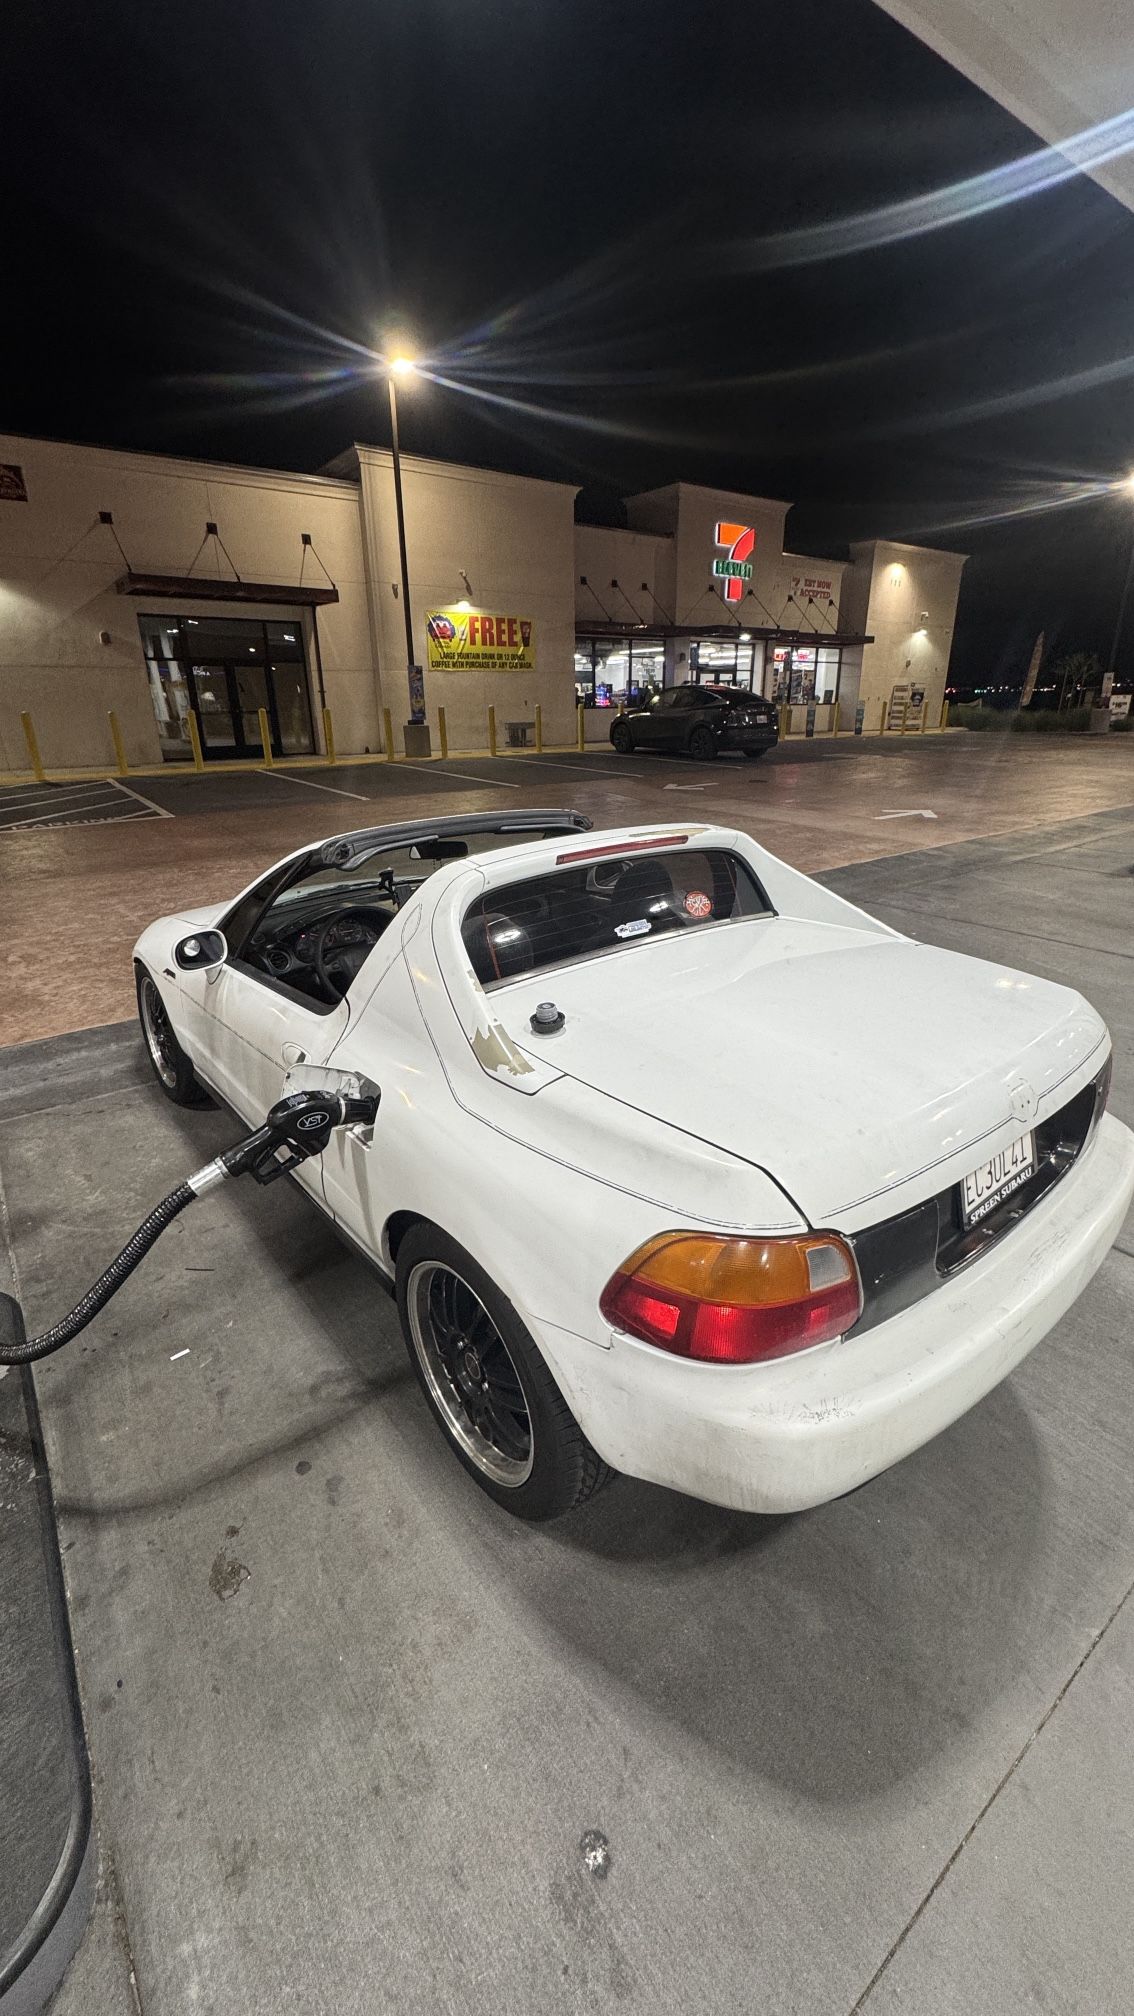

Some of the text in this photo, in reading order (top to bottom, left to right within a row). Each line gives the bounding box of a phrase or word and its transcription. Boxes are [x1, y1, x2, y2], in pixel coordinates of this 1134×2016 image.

[715, 522, 755, 601] 7
[817, 579, 832, 589] NOW
[800, 588, 831, 599] ACCEPTED
[468, 615, 519, 647] FREE
[440, 652, 456, 660] LARGE
[457, 652, 480, 660] FOUNTAIN
[511, 653, 525, 661] OUNCE
[432, 660, 451, 668] COFFEE
[452, 660, 465, 668] WITH
[466, 660, 490, 668] PURCHASE
[509, 661, 518, 669] CAR
[303, 1114, 323, 1128] VST
[970, 1166, 1034, 1224] SPREEN SUBARU
